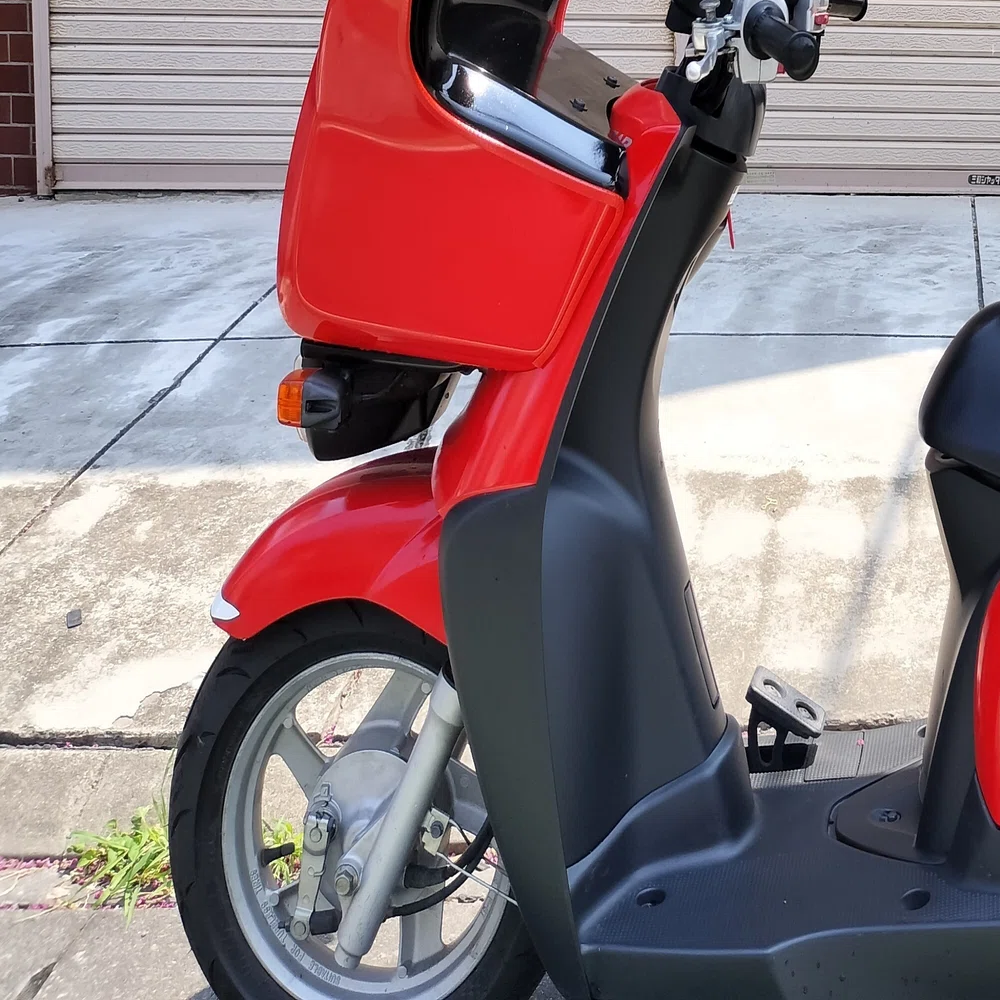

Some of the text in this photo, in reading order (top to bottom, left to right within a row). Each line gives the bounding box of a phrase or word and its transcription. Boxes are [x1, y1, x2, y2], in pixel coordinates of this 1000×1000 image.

[250, 869, 263, 895] TIRES
[290, 943, 306, 962] FOR
[308, 960, 342, 986] SUITABLE
